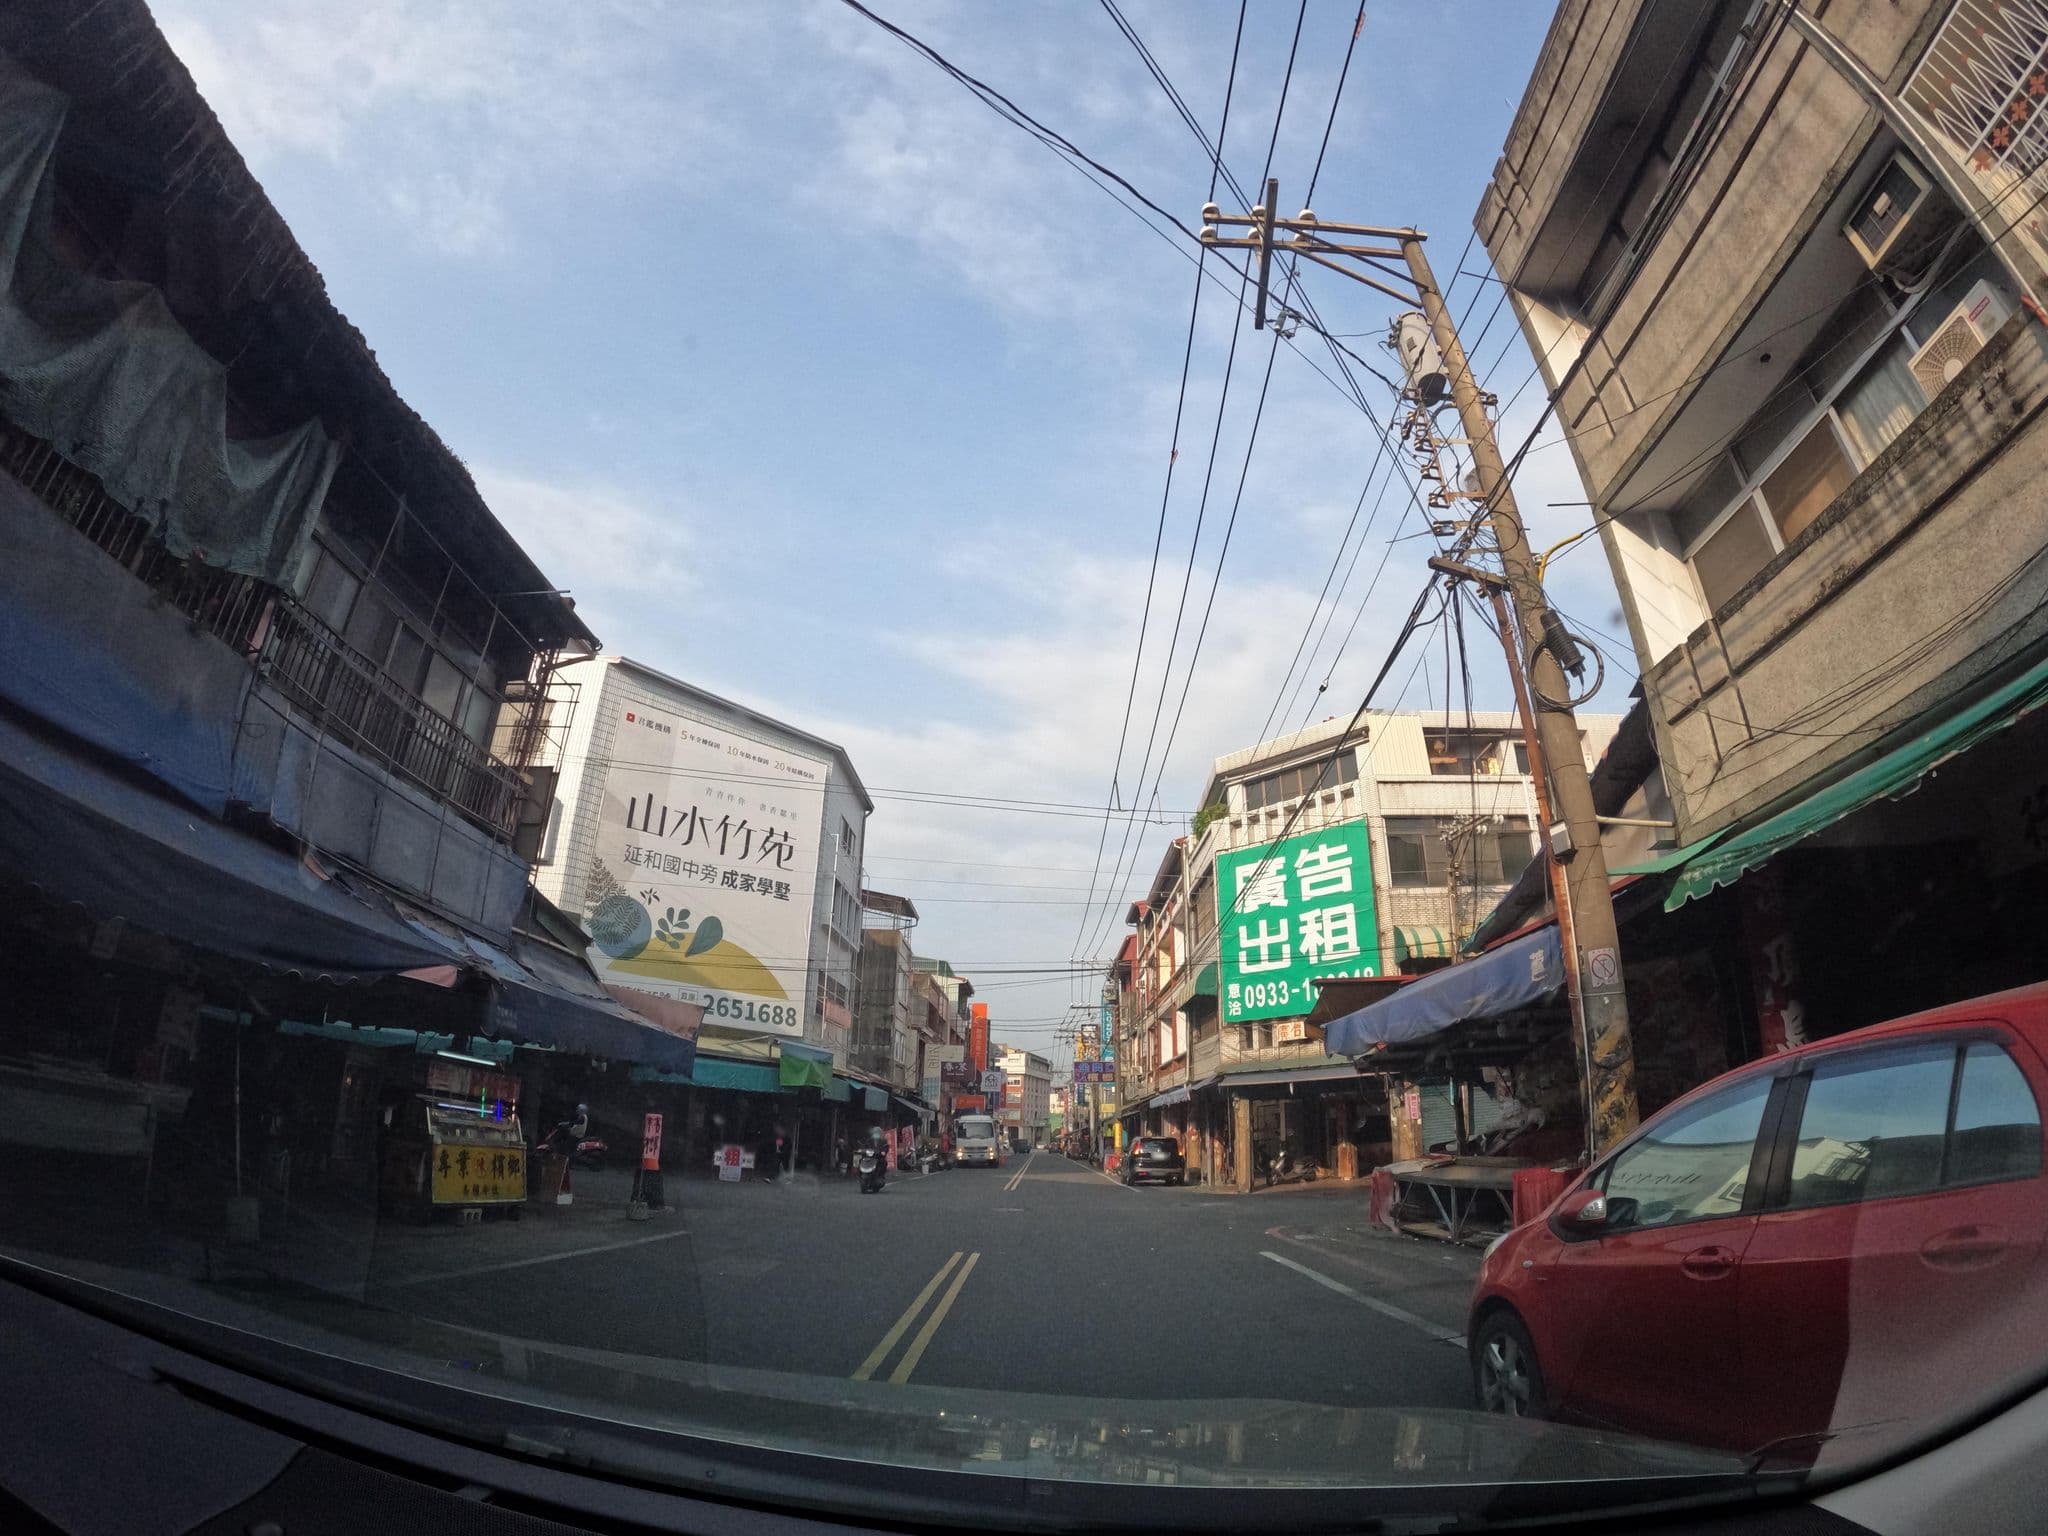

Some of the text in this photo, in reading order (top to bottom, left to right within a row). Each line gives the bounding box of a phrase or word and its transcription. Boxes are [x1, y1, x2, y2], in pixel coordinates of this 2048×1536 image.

[626, 792, 797, 871] 山水竹苑
[623, 844, 792, 902] 延和國中旁 成家學墅
[1235, 843, 1352, 914] 廣告
[1238, 903, 1361, 974] 出租
[703, 993, 797, 1027] 2651688
